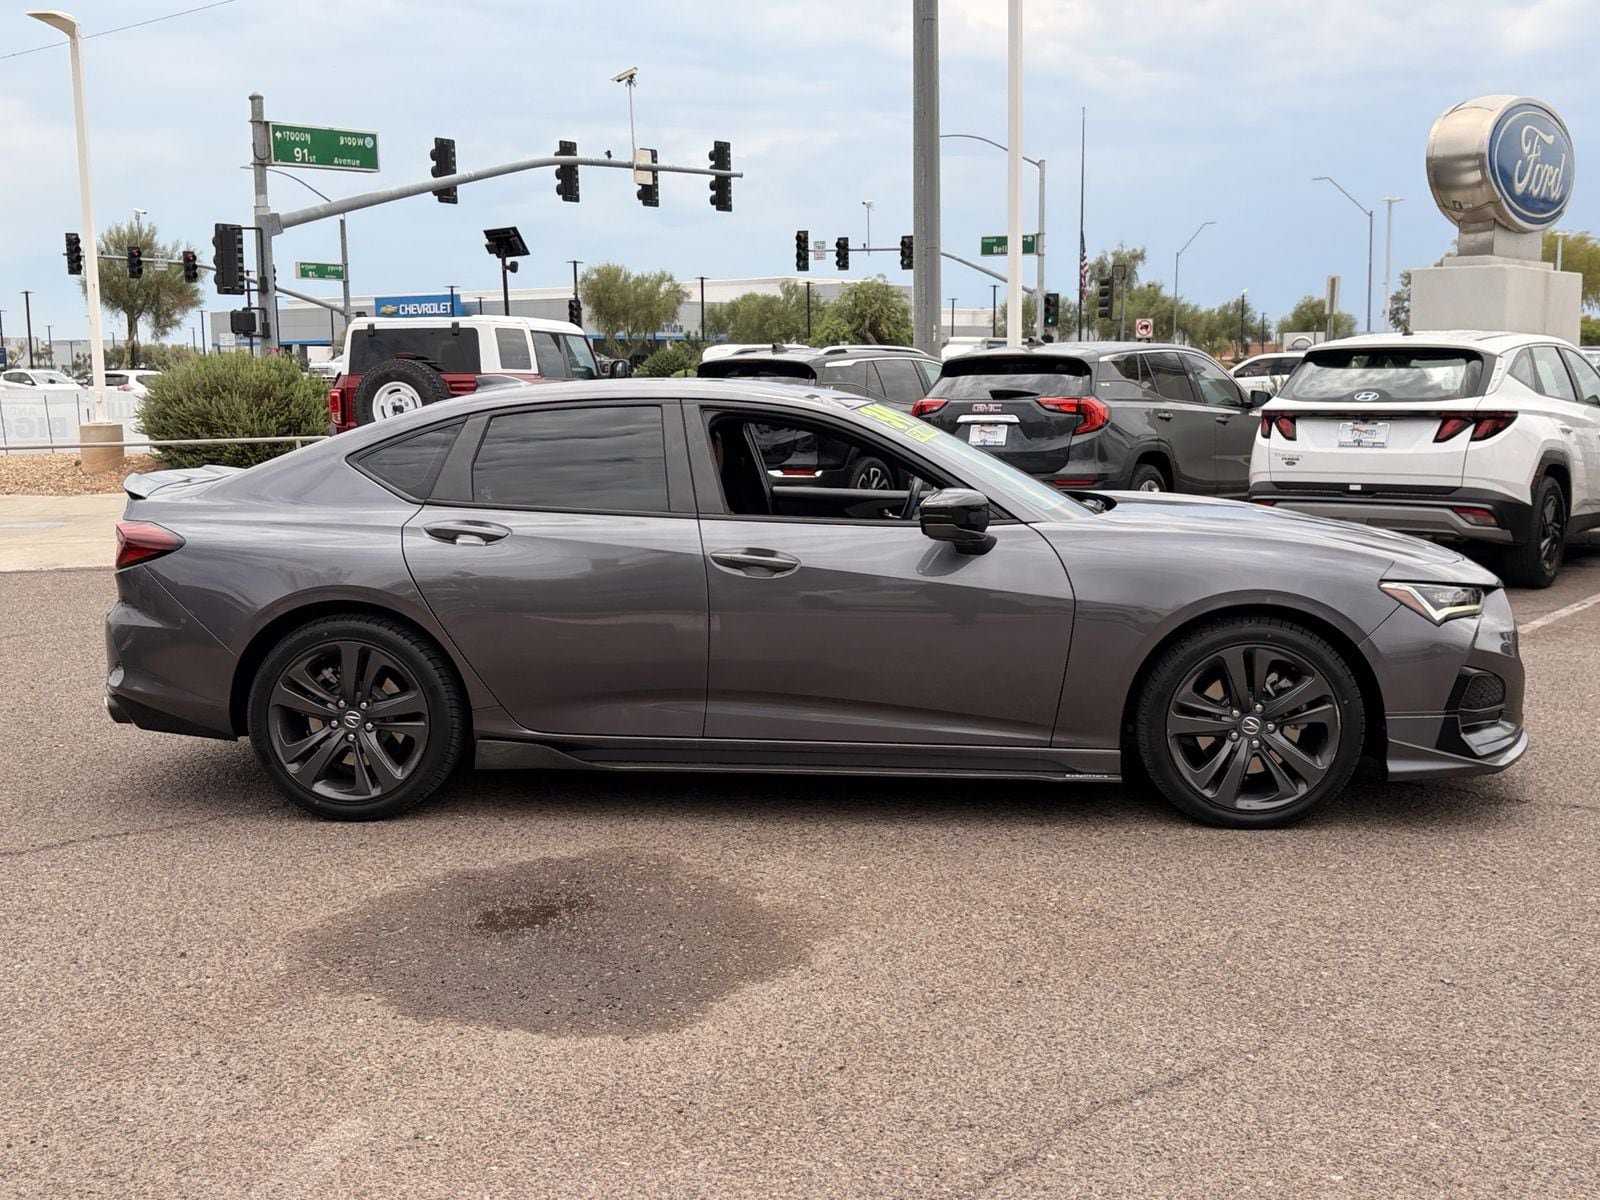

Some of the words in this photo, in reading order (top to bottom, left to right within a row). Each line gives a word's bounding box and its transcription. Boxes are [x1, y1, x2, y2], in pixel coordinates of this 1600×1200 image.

[293, 147, 317, 163] 91st
[333, 157, 361, 167] Avenue
[1515, 125, 1566, 199] Ford
[399, 302, 452, 315] CHEVROLET
[972, 403, 1002, 412] GMC
